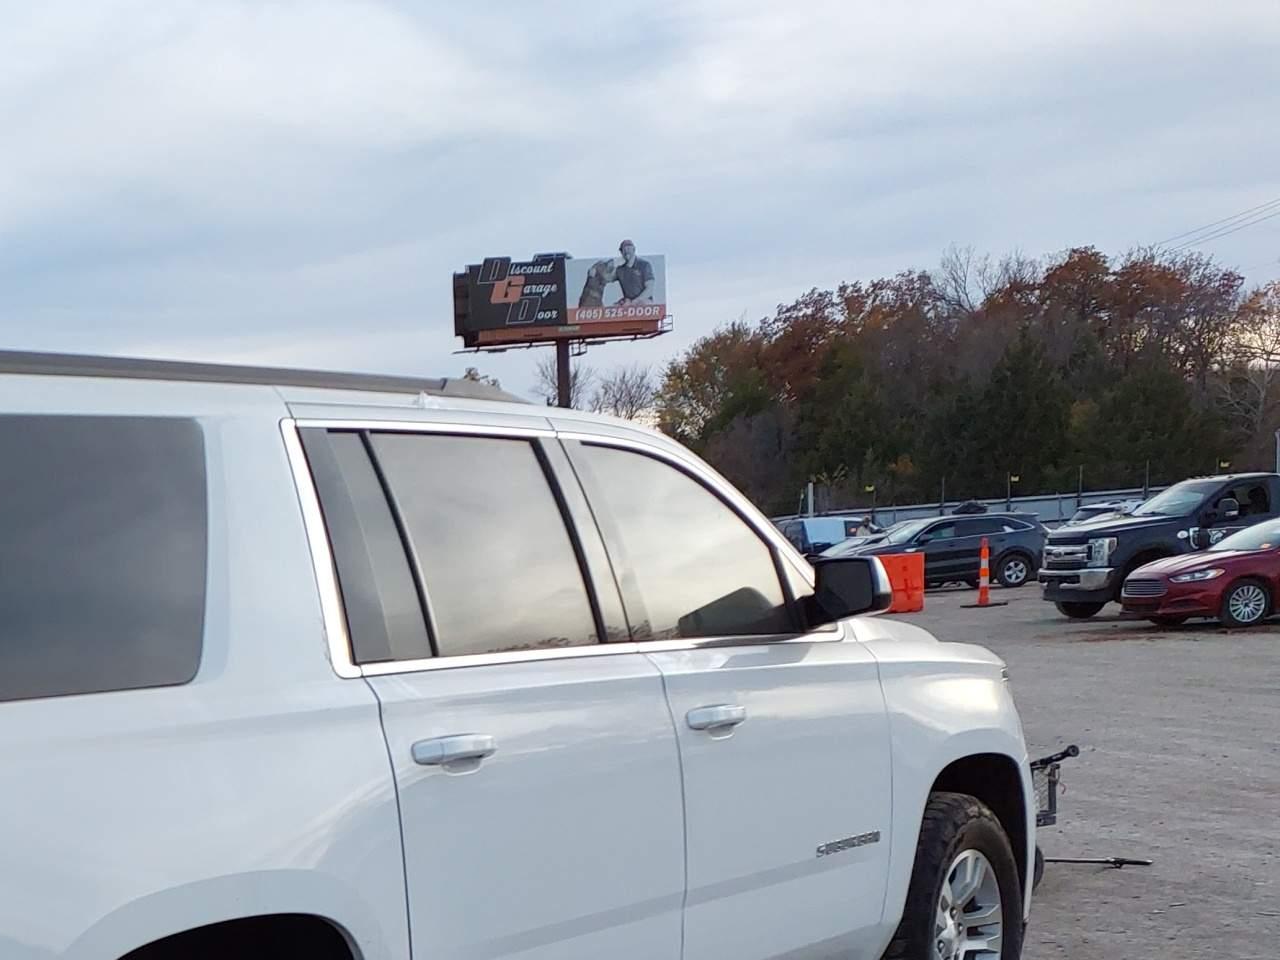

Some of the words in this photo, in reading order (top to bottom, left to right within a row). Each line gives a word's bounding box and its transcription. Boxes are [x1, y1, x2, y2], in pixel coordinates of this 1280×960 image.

[478, 256, 554, 285] Discount
[490, 275, 558, 304] Garage
[506, 296, 559, 324] Door
